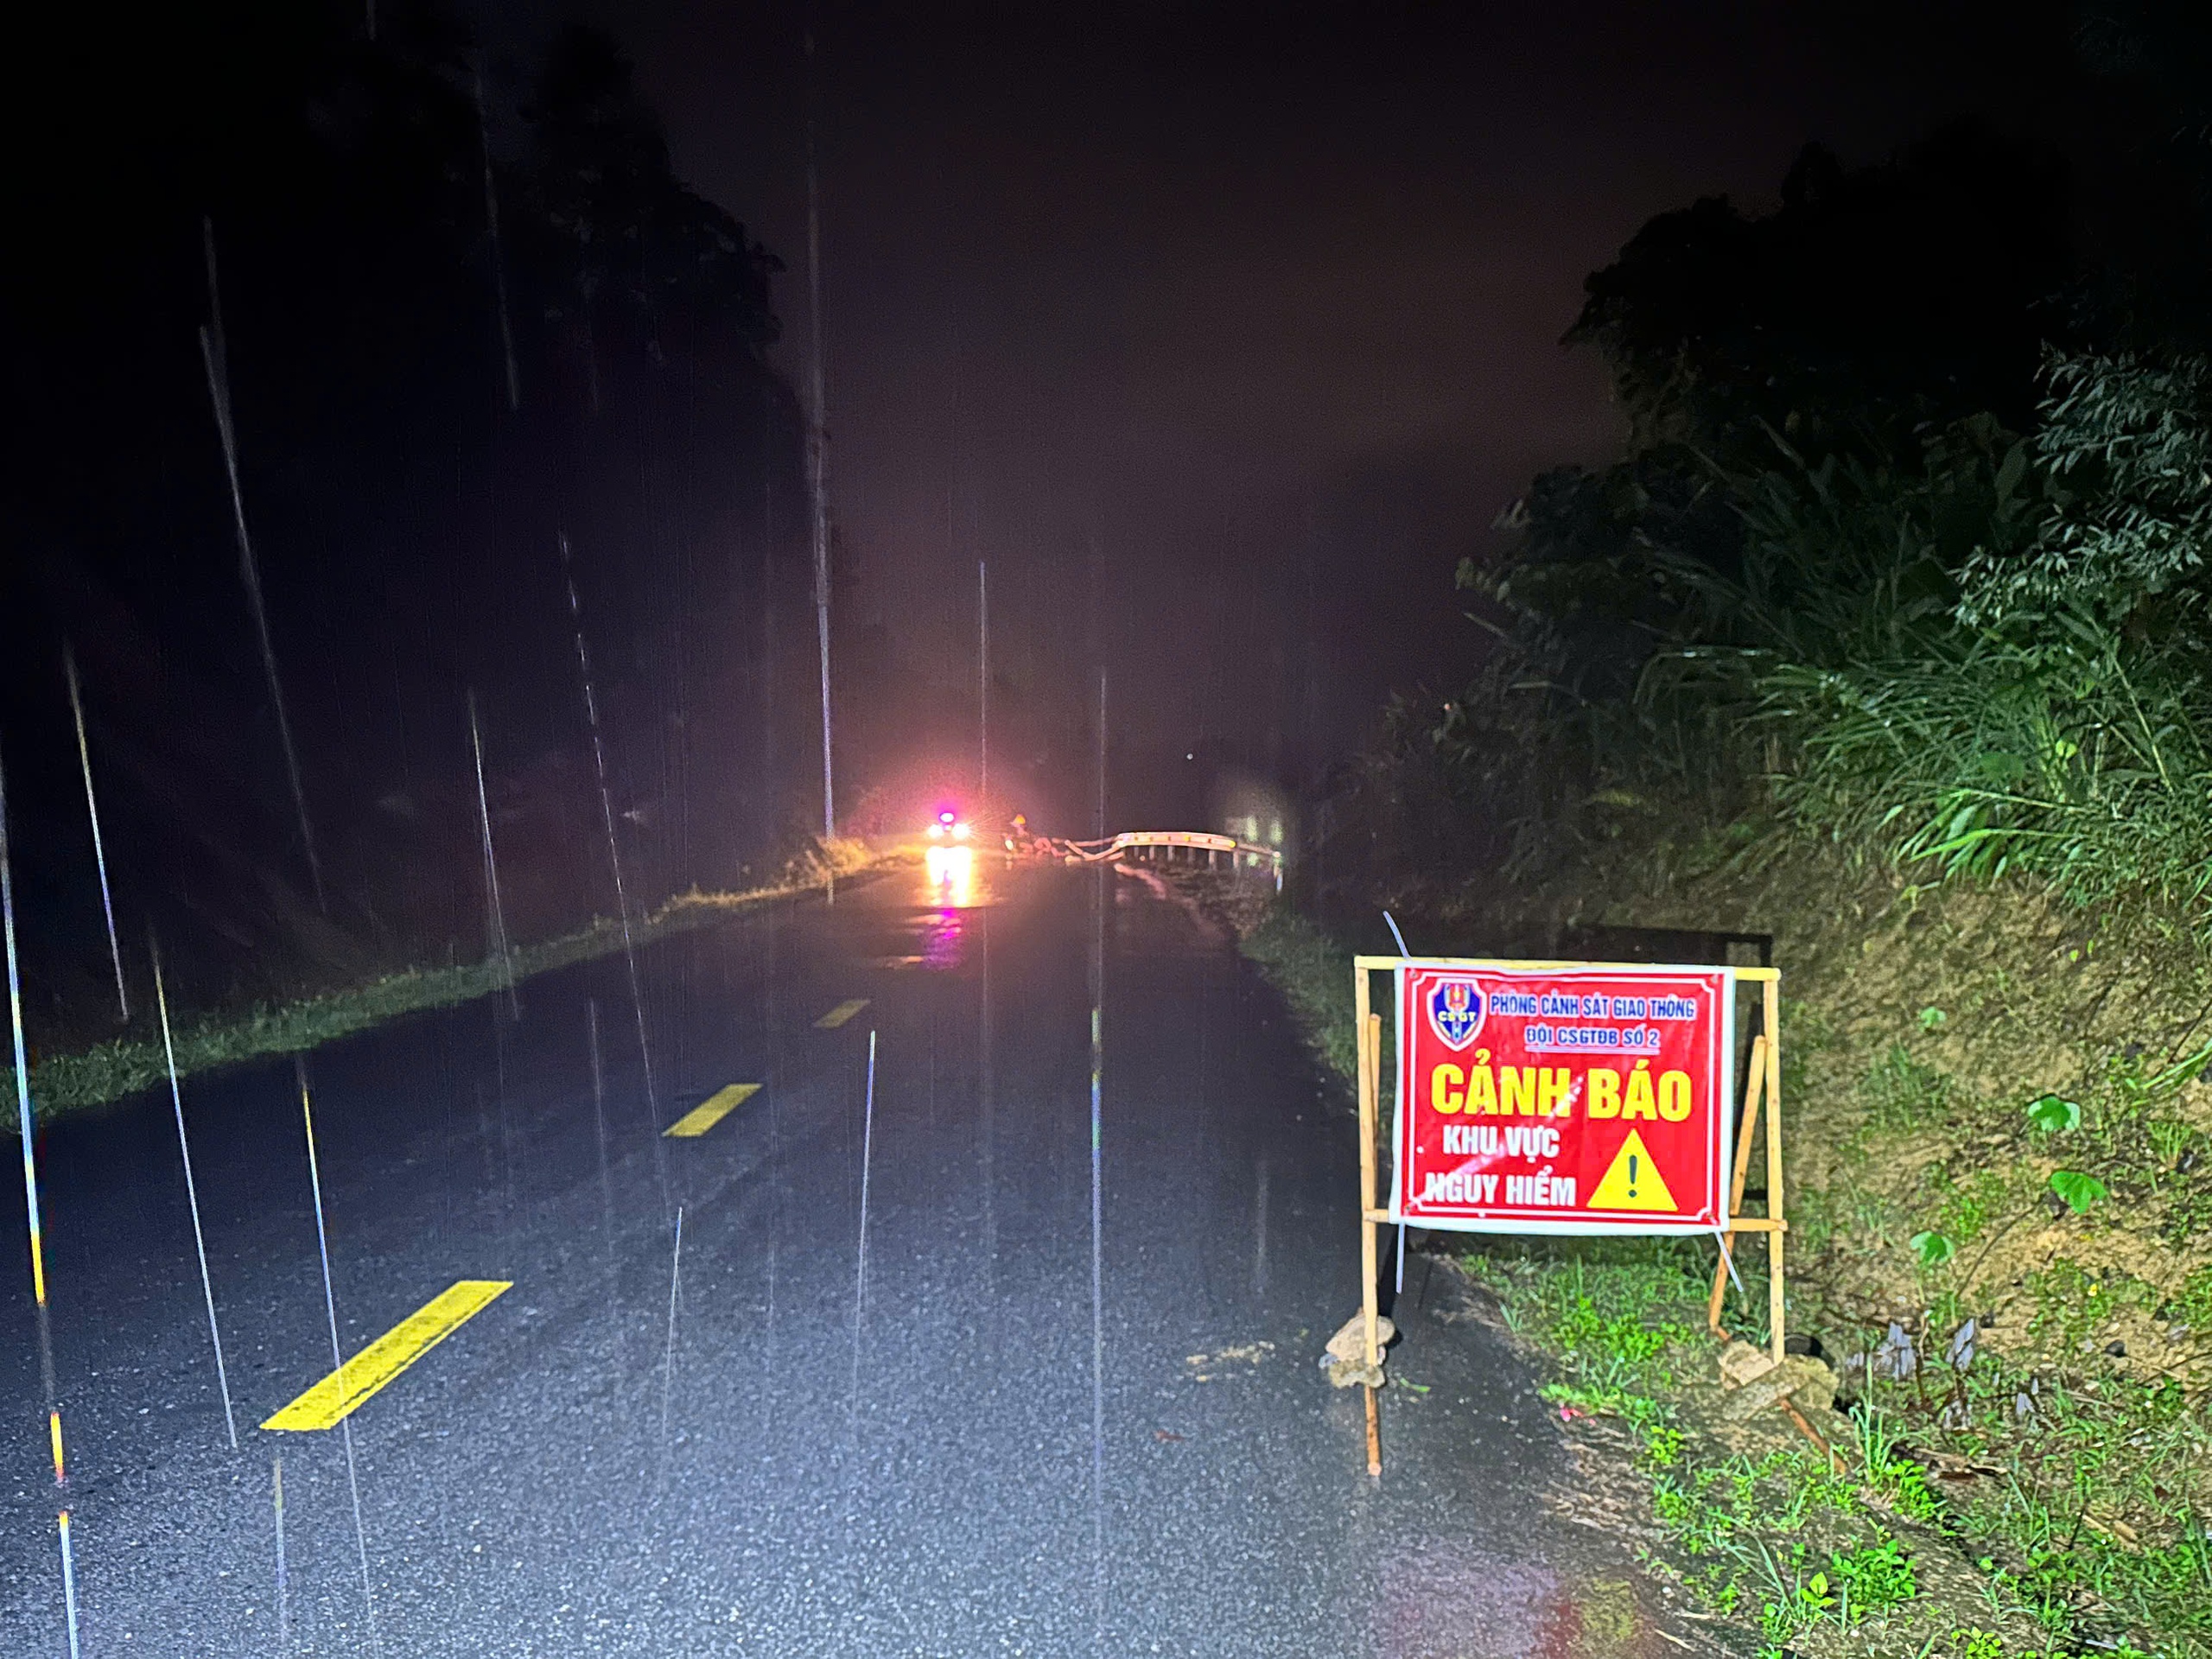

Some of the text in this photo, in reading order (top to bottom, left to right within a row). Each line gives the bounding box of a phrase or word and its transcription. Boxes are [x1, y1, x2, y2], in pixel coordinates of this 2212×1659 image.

[1490, 989, 1695, 1019] PHÒNG CẢNH SÁT GIAO THÔNG
[1526, 1023, 1659, 1046] ĐỘI CSGTĐB SỐ 2
[1431, 1048, 1692, 1122] CẢNH BÁO
[1443, 1126, 1560, 1163] KHU VỰC
[1425, 1165, 1576, 1206] NGUY HIỂM
